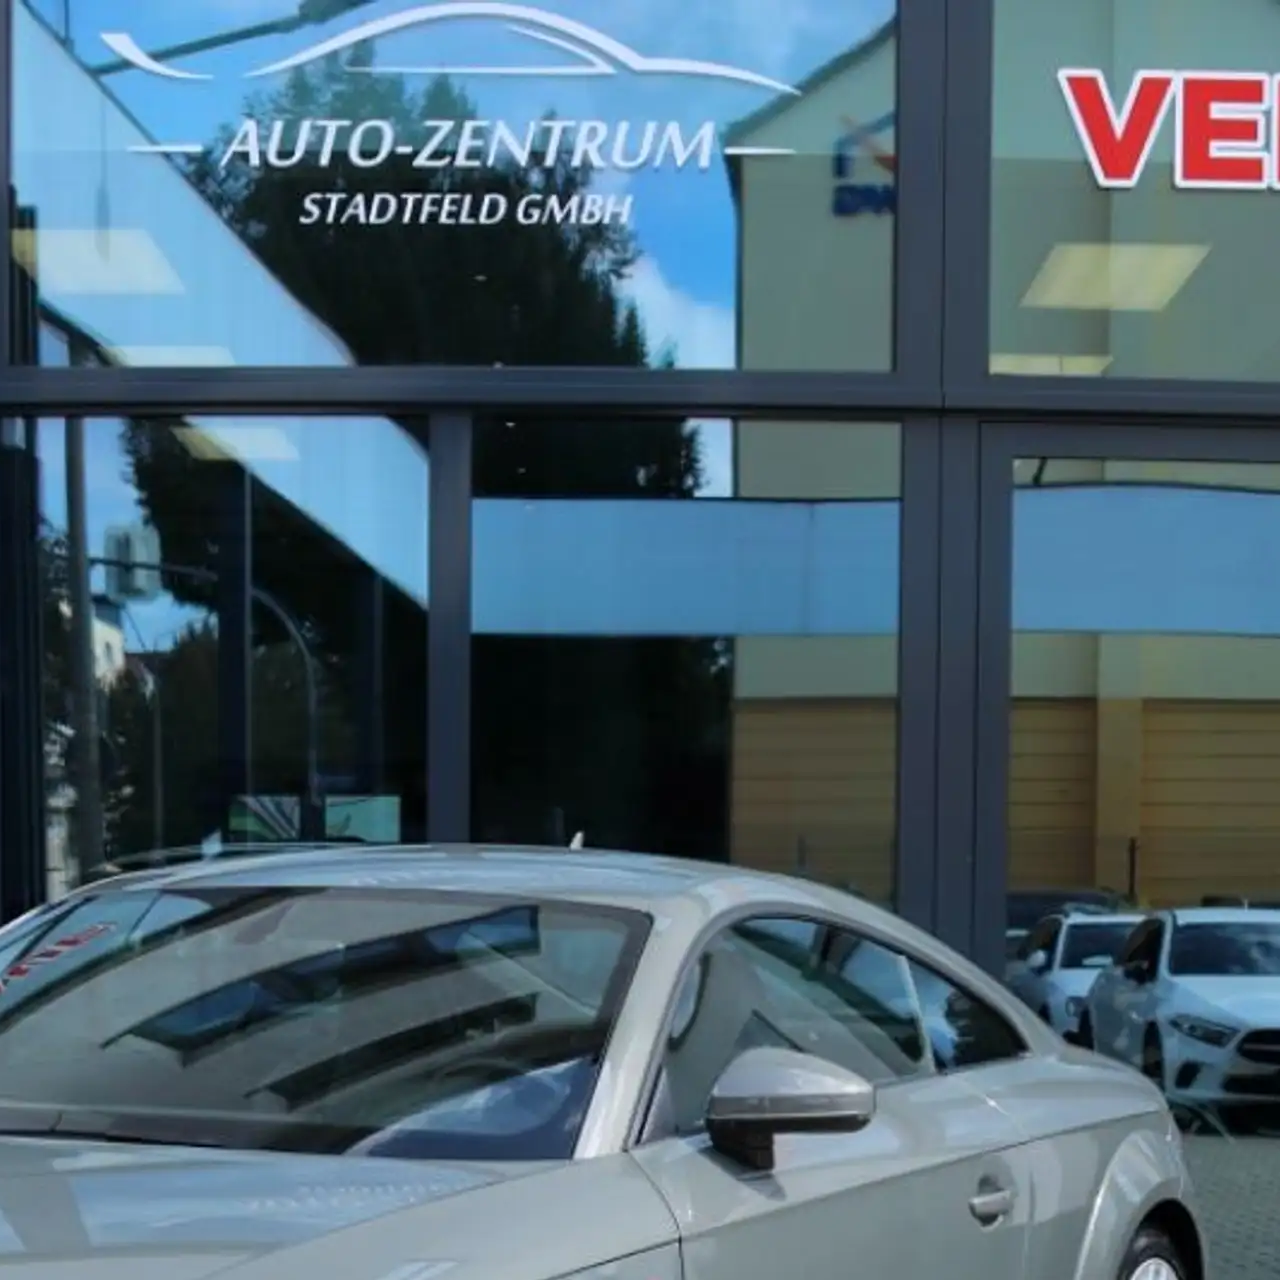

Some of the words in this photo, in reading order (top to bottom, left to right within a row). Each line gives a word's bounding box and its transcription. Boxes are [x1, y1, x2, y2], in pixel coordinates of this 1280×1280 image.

[222, 117, 717, 171] AUTO-ZENTRUM
[298, 192, 508, 226] STADTFELD
[516, 193, 632, 227] GMBH
